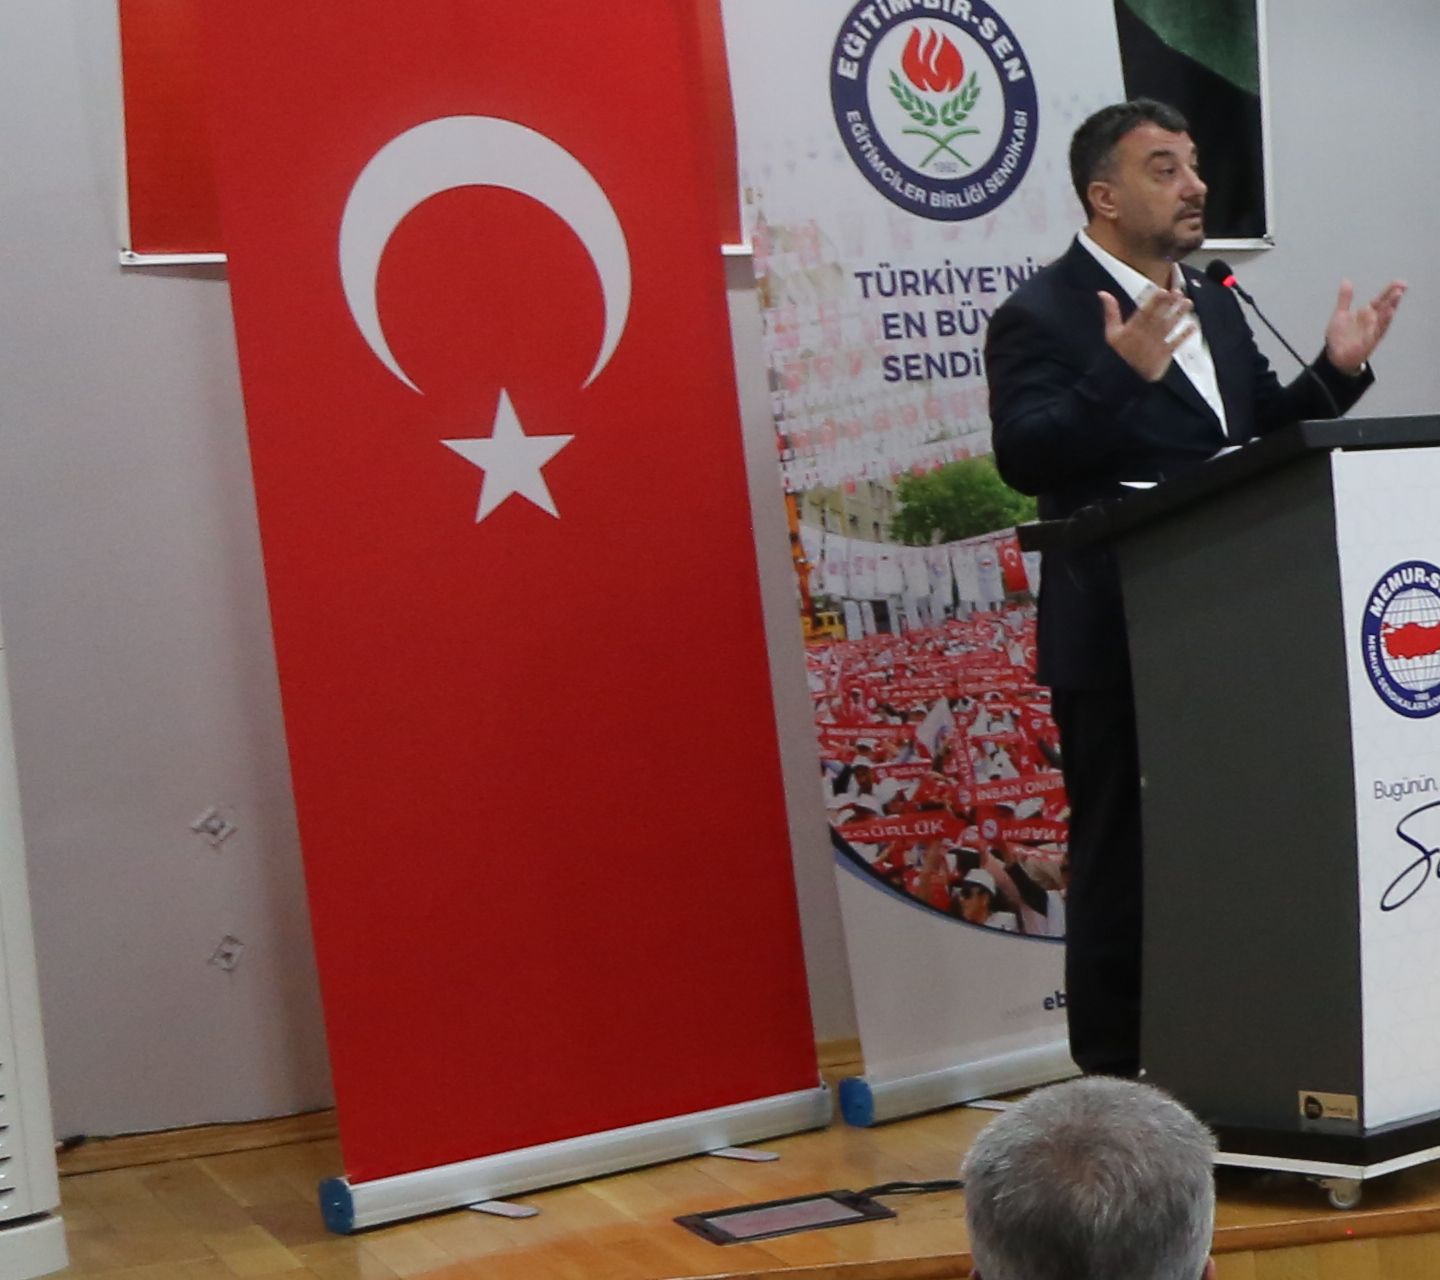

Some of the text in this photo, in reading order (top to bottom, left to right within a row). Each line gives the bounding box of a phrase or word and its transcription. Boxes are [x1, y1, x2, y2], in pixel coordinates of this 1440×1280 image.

[854, 257, 1046, 298] TÜRKİYE'Nİ
[882, 311, 927, 340] EN
[1043, 990, 1067, 1011] eb
